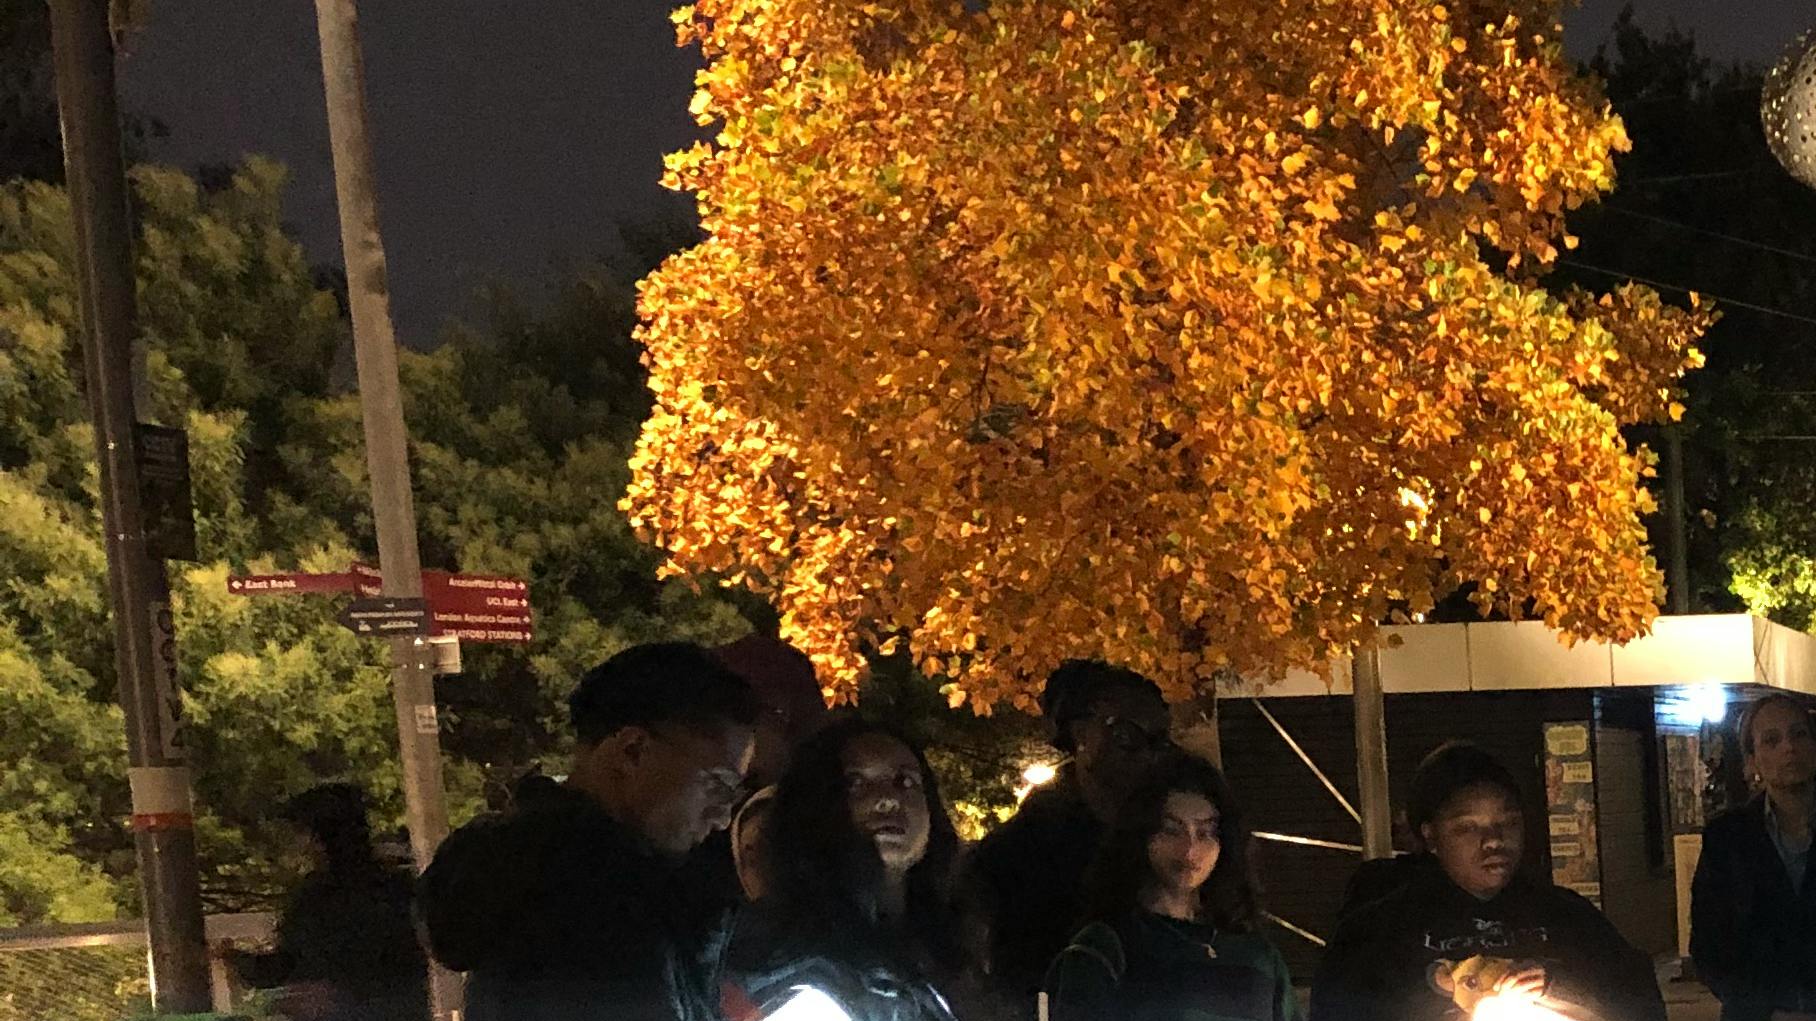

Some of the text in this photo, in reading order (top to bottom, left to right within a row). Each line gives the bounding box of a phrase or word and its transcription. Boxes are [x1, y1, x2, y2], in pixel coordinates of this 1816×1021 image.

[244, 579, 297, 589] East Bank
[486, 596, 519, 607] UCL East
[433, 611, 463, 622] London
[464, 613, 496, 624] Aquatics
[488, 630, 523, 640] STATIONS
